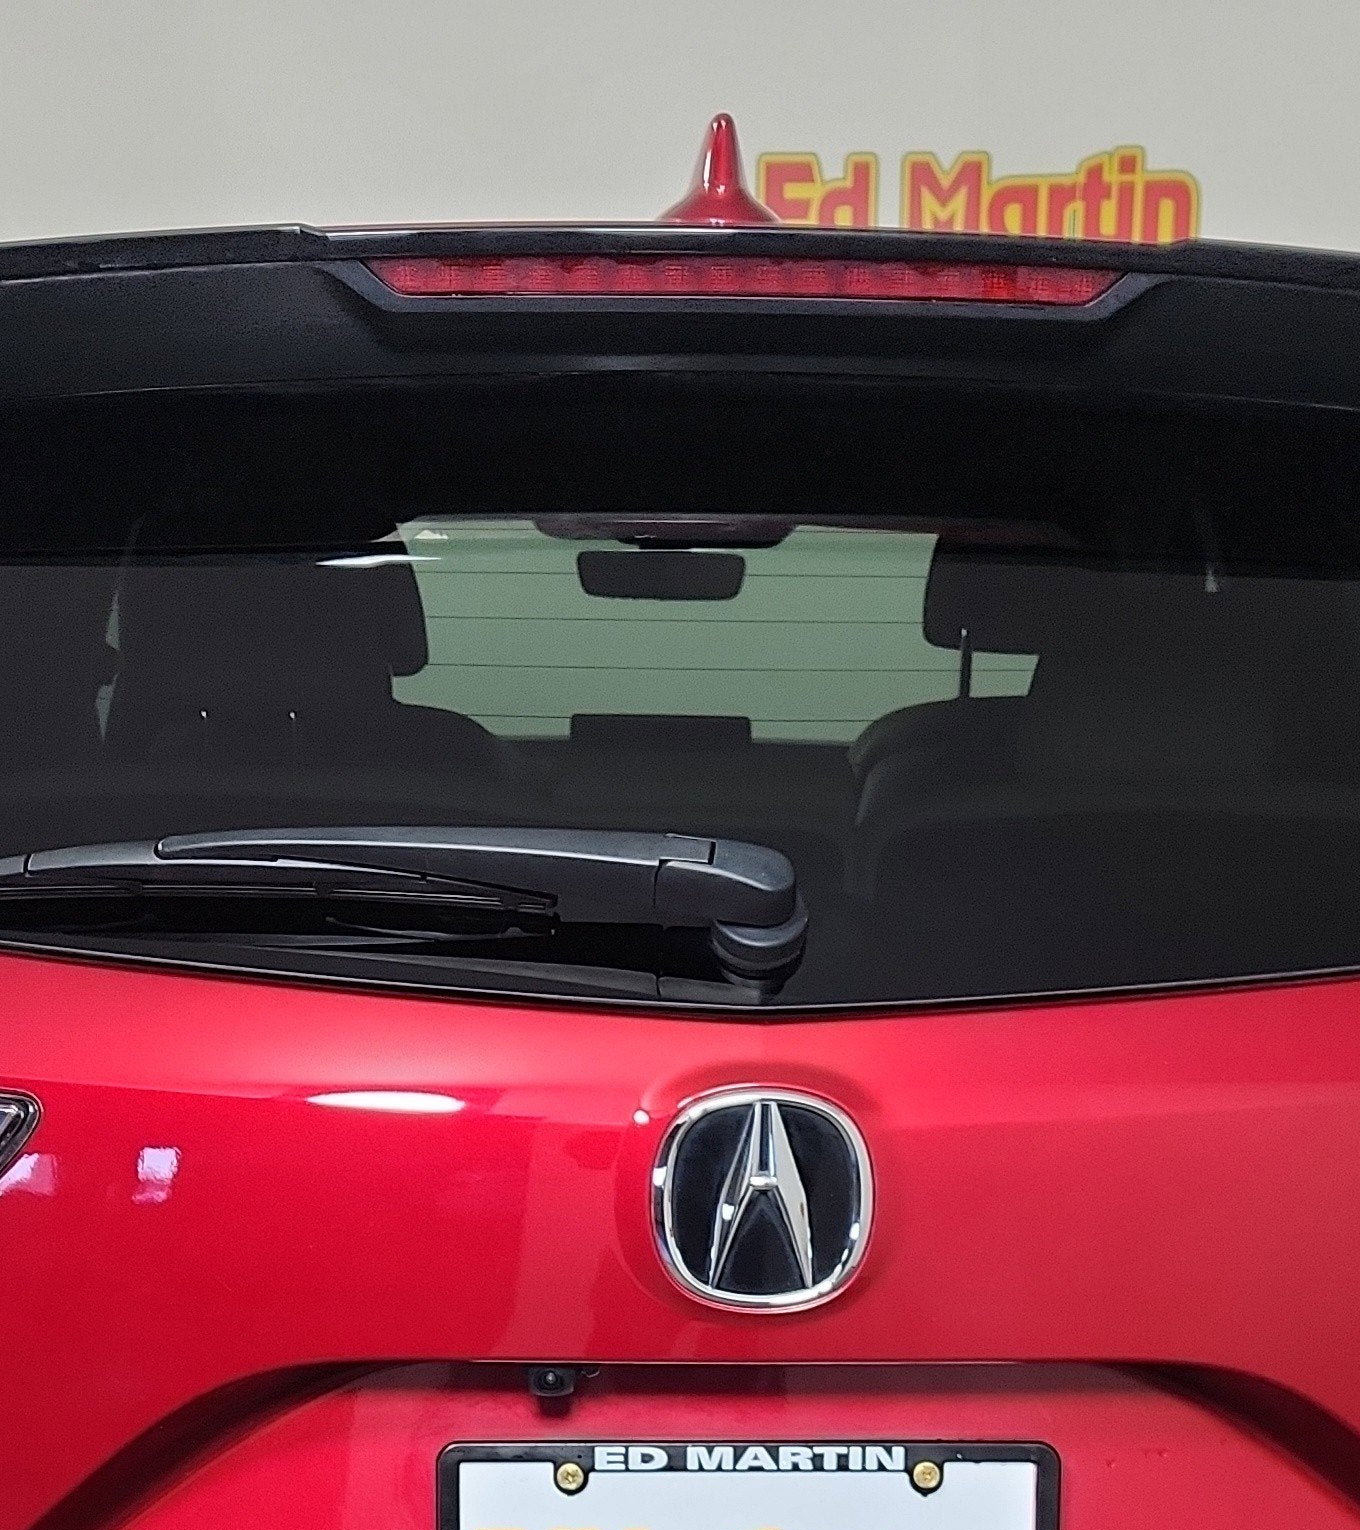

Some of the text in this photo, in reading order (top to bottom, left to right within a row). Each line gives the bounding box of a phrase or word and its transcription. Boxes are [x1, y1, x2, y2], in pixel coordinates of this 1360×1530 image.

[761, 156, 1196, 242] Ed Martin
[593, 1445, 907, 1472] ED MARTIN
